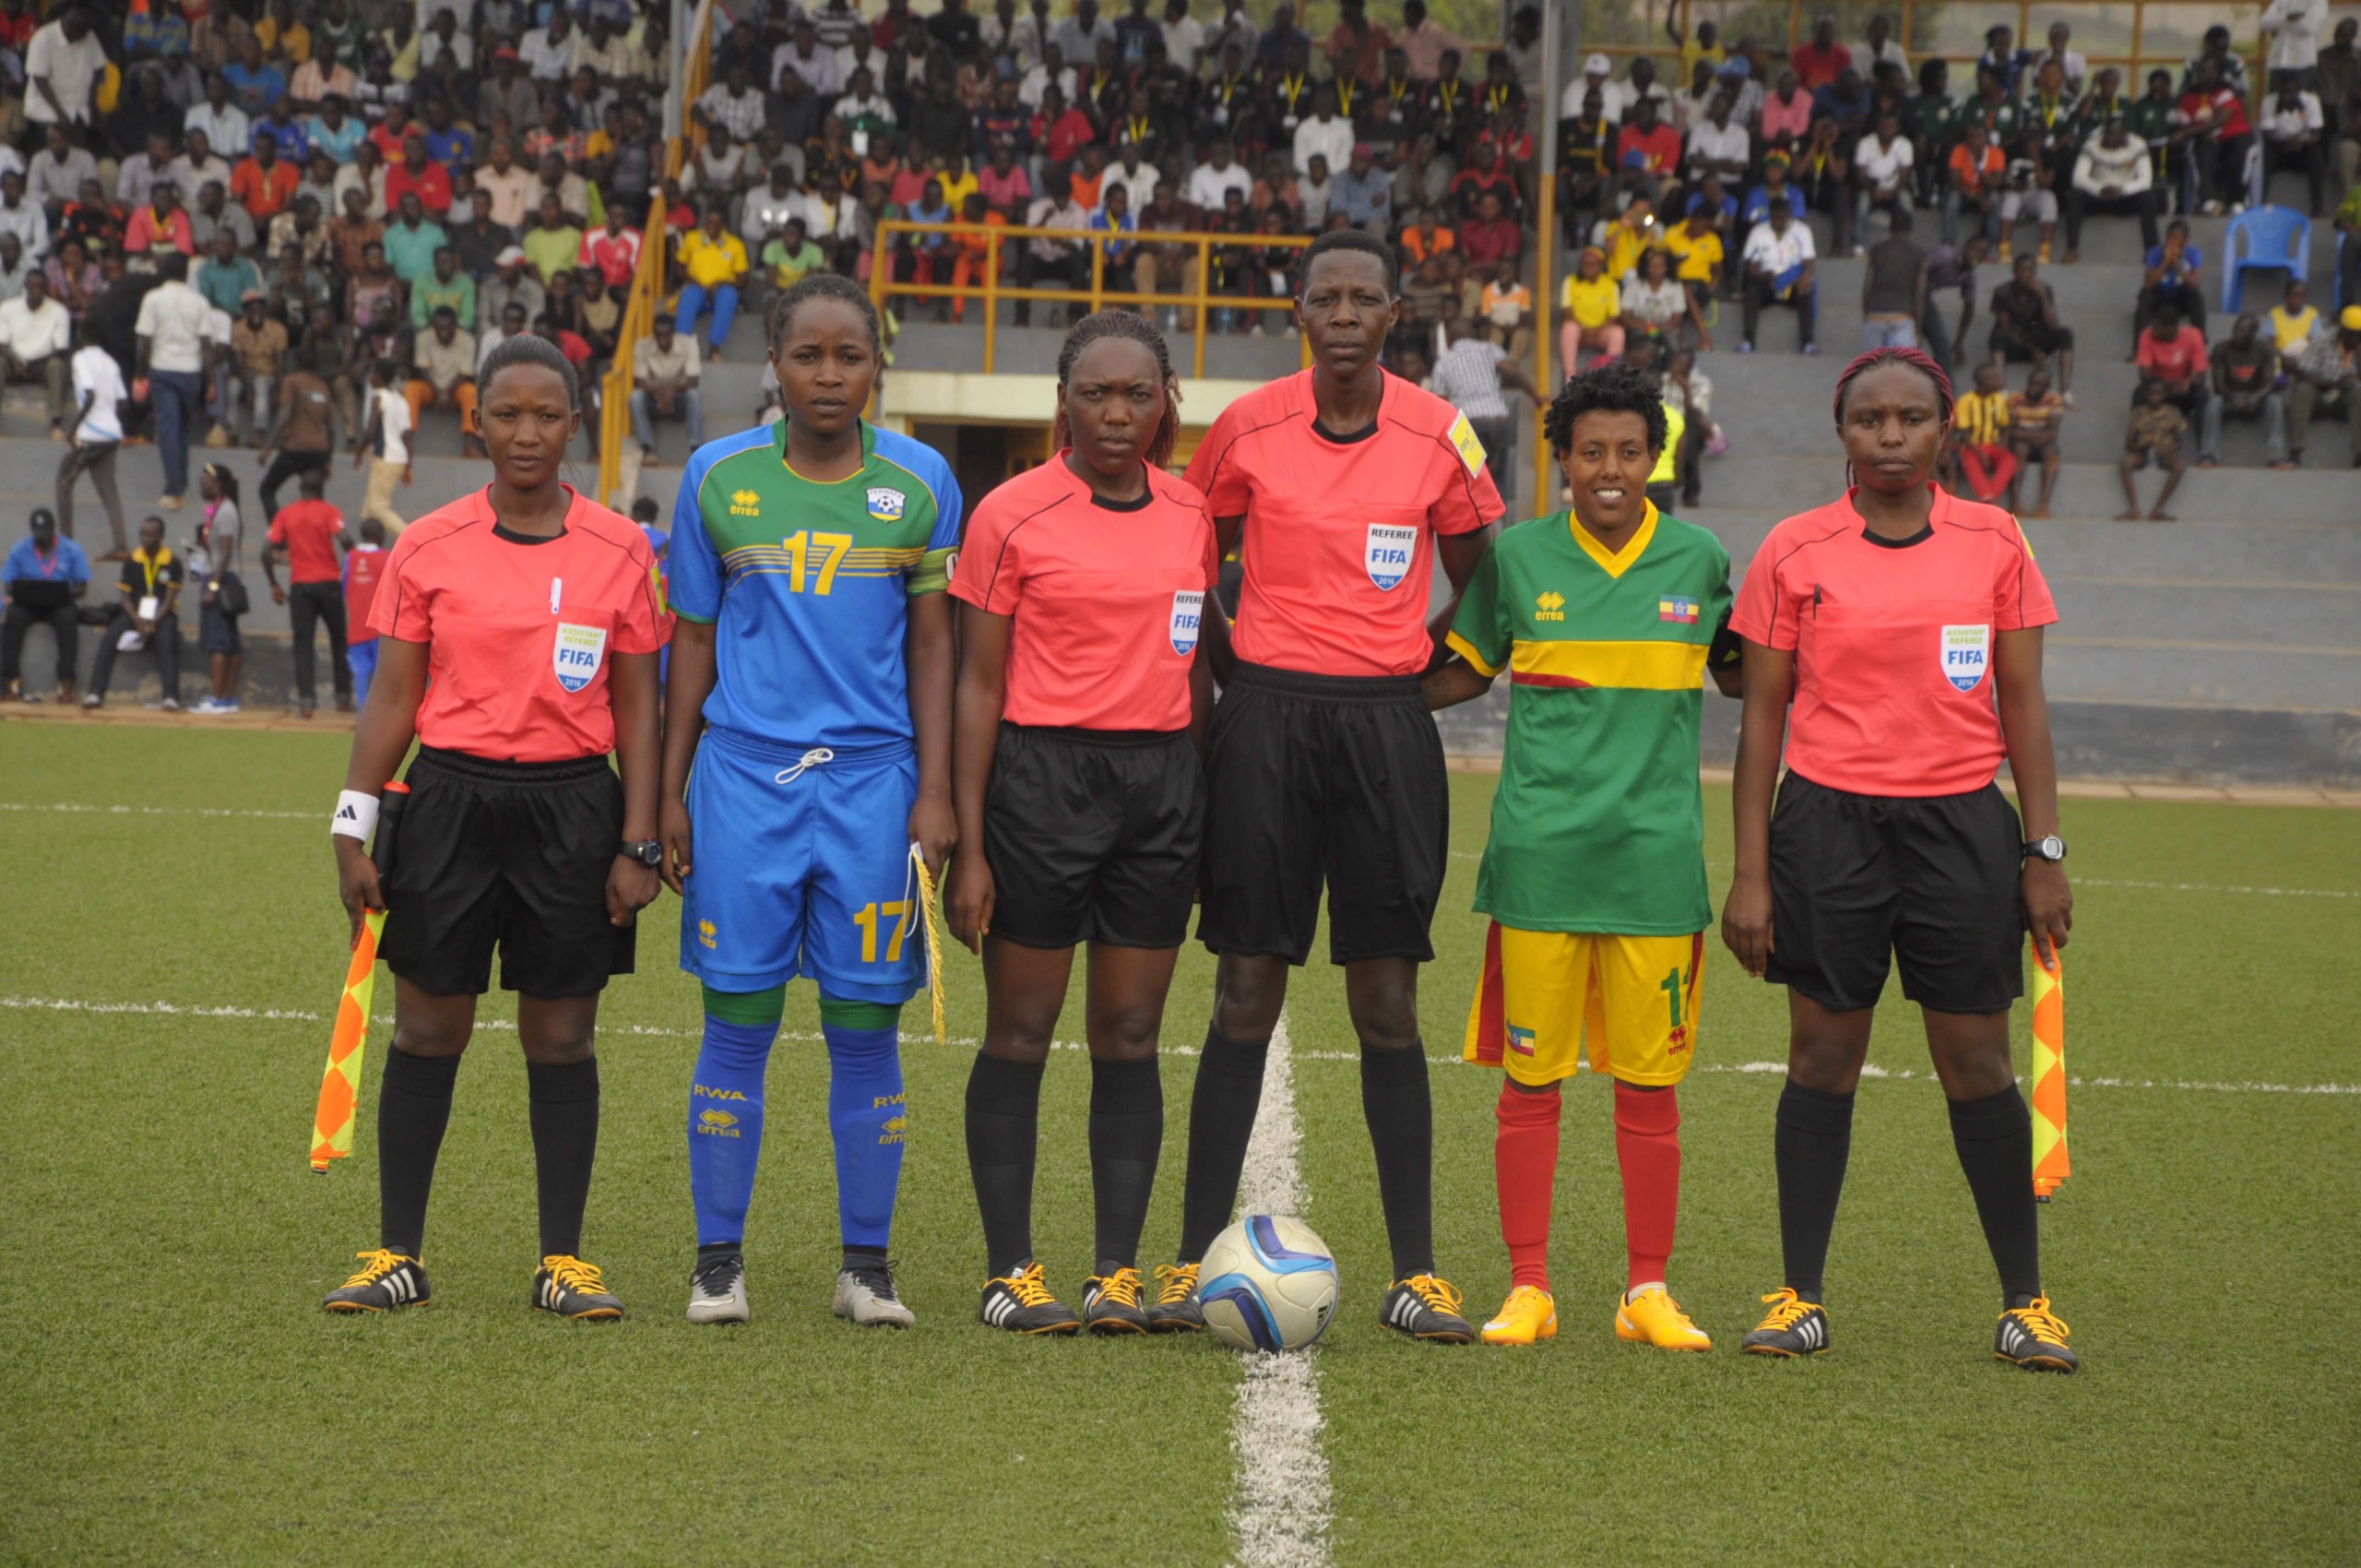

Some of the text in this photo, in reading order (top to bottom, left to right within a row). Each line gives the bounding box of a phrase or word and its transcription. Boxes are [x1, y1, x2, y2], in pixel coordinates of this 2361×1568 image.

[1371, 529, 1414, 540] REFEREE
[1371, 548, 1406, 564] FIFA
[783, 530, 852, 596] 17
[1378, 576, 1394, 585] 2016
[1536, 611, 1564, 622] errea
[562, 627, 602, 639] ASSISTANT
[1946, 628, 1986, 636] ASSISTANT
[564, 636, 598, 647] REFEREE
[1949, 636, 1983, 645] REFEREE
[559, 648, 594, 667] FIFA
[1948, 649, 1983, 664] FIFA
[564, 678, 582, 687] 2016
[1958, 678, 1975, 687] 2016
[853, 899, 913, 962] 17
